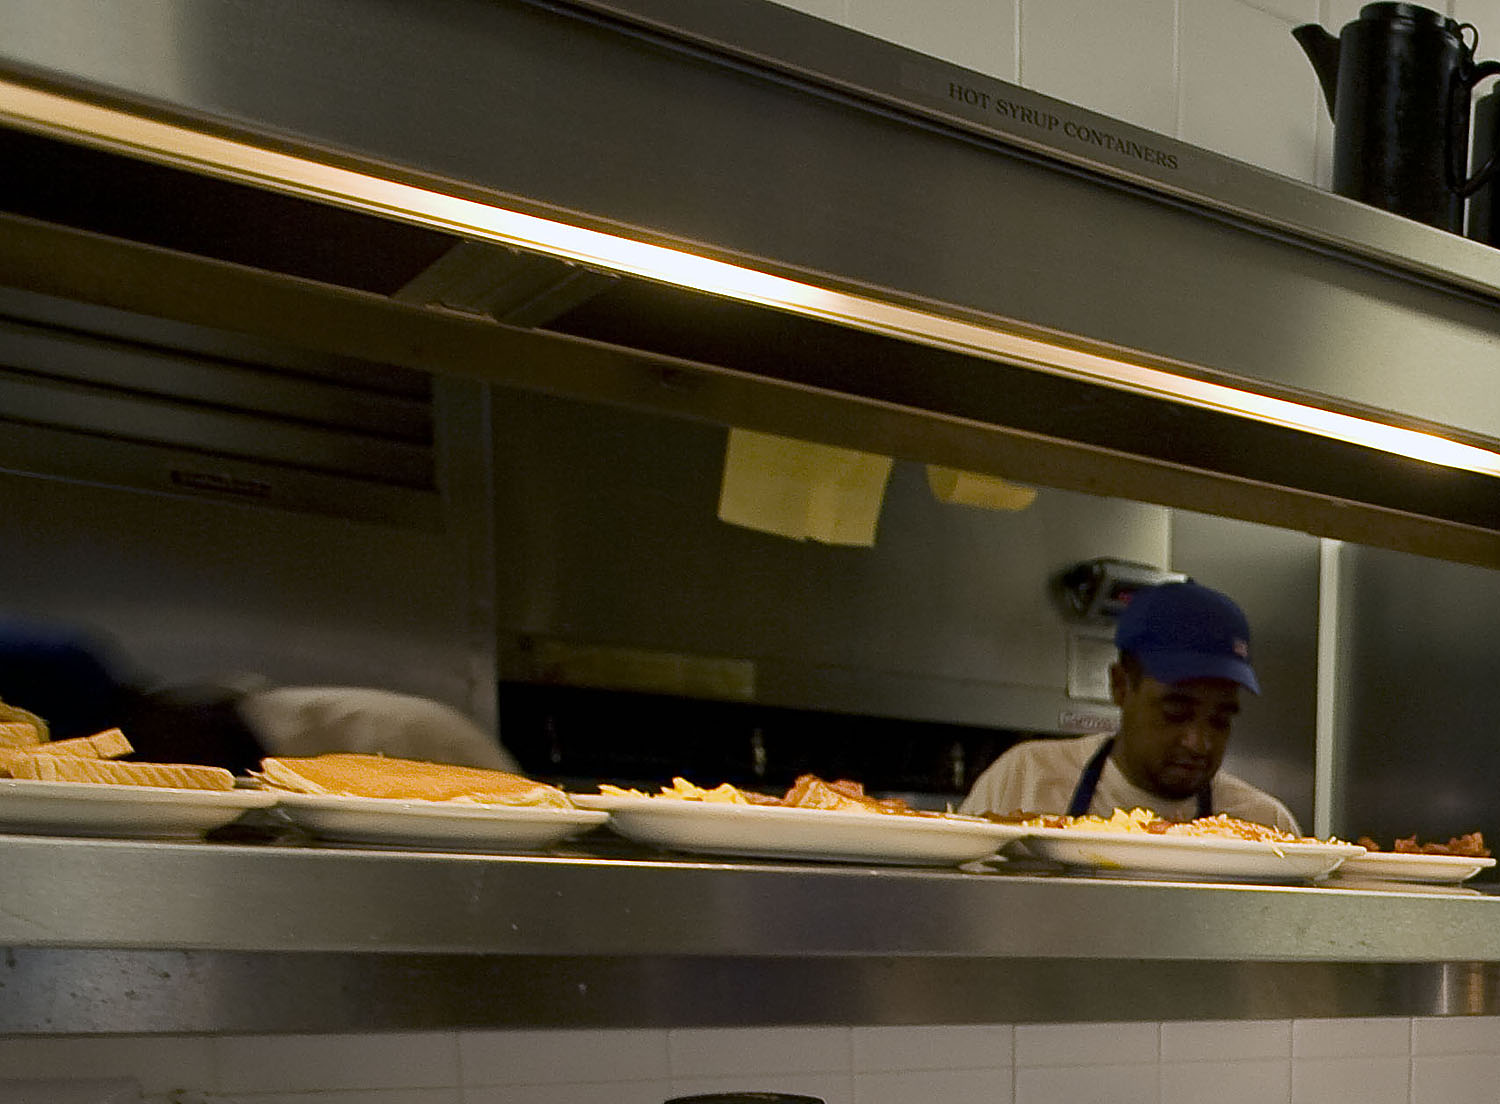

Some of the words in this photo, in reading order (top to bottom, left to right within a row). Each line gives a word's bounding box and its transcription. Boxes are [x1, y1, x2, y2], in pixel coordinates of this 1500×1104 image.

[949, 82, 990, 110] HOT
[997, 99, 1059, 130] SYRUP
[1064, 121, 1178, 170] CONTAINERS
